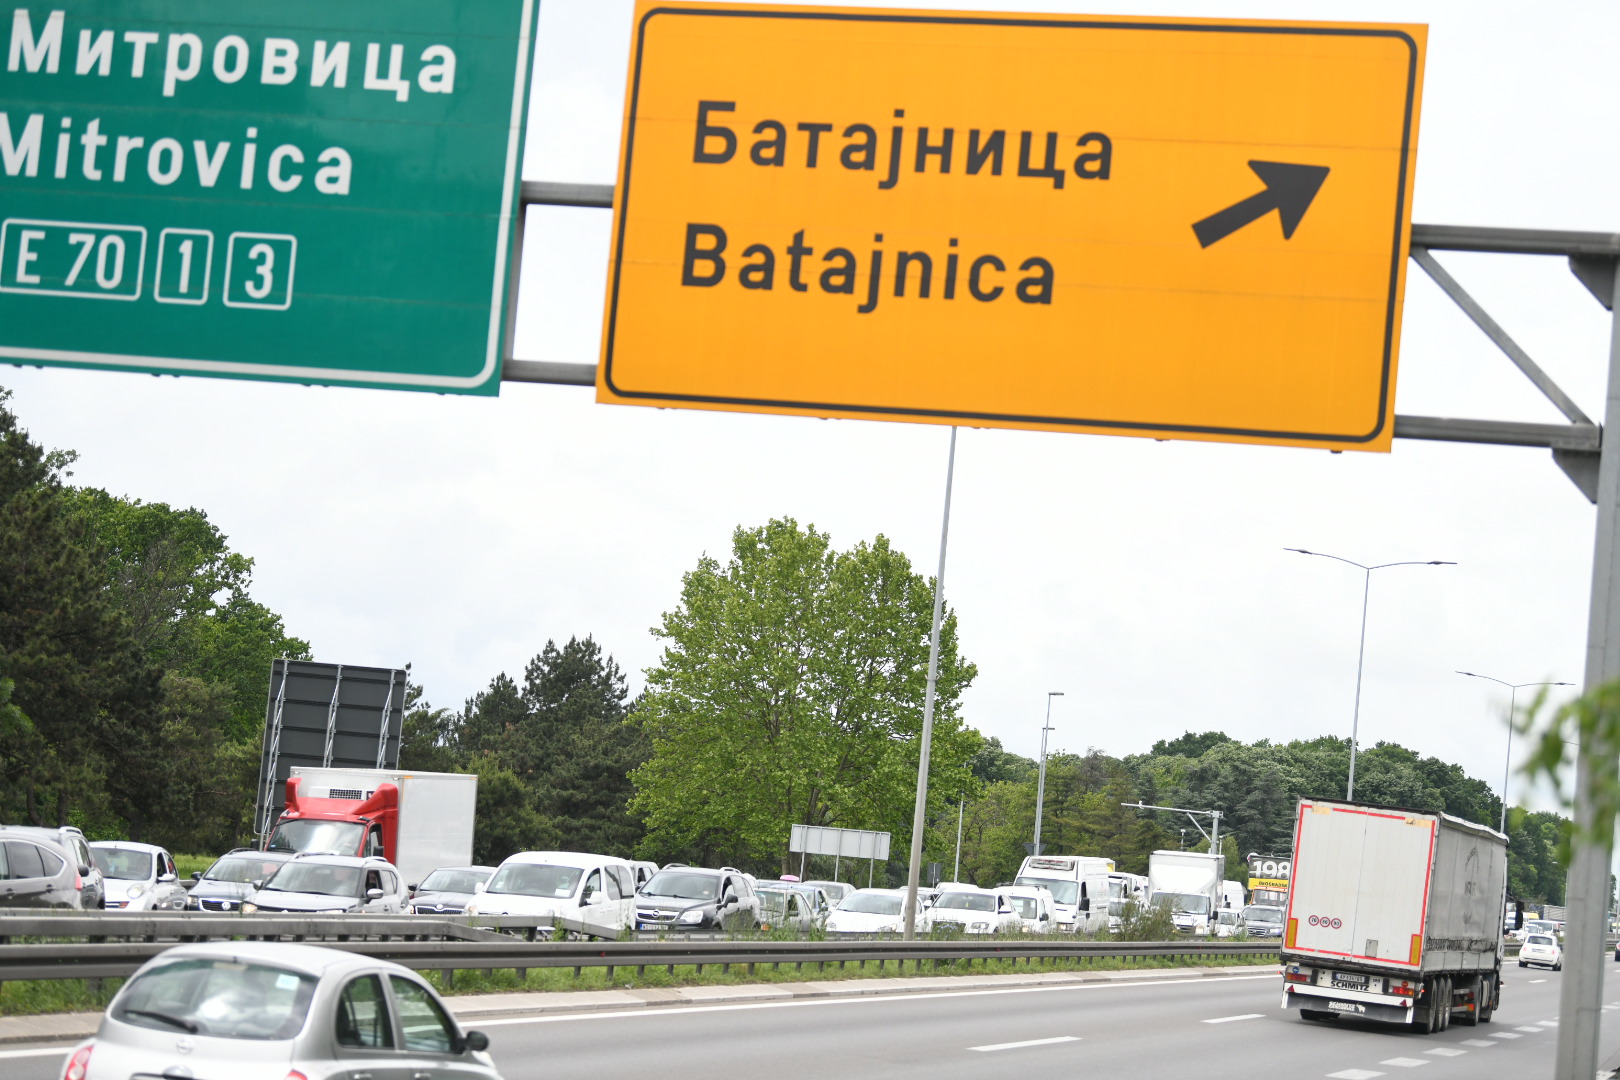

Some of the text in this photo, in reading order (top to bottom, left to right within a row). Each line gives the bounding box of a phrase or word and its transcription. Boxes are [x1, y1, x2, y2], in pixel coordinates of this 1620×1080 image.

[8, 9, 456, 102] Митровица
[0, 112, 352, 195] Mitrovica
[692, 100, 1112, 190] Батајница
[16, 229, 125, 289] E 70
[178, 239, 194, 294] 1
[245, 243, 275, 299] 3
[681, 222, 1055, 314] Batajnica
[1331, 980, 1370, 992] SCHMITZ
